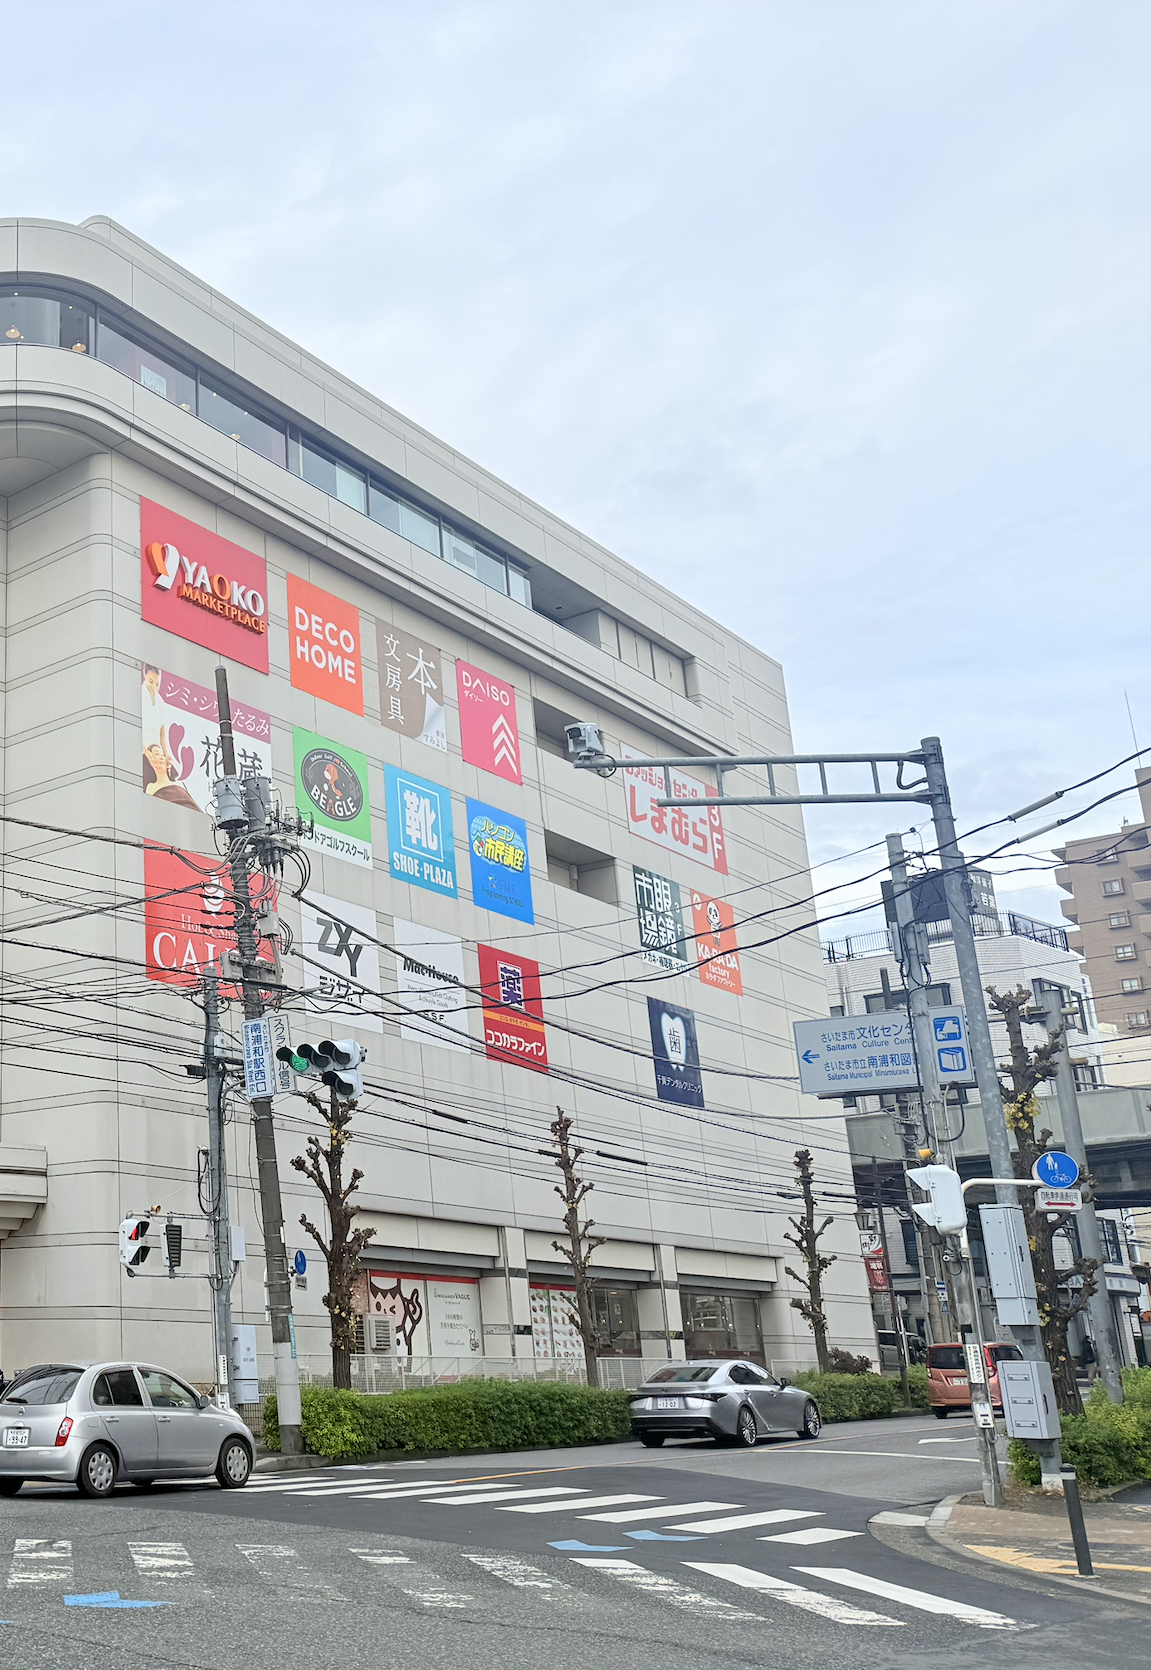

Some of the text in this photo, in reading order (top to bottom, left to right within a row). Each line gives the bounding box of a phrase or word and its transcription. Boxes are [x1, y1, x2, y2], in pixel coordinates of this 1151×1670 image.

[180, 555, 265, 617] YAOKO
[180, 583, 266, 634] MARKETPLACE
[295, 605, 355, 654] DECO
[296, 635, 357, 684] HOME
[383, 633, 405, 725] 文房具
[406, 647, 438, 695] 本
[462, 670, 510, 707] DAISO
[463, 689, 484, 703] ダイソー
[310, 784, 358, 817] BEAGLE
[403, 788, 438, 851] 靴
[630, 784, 708, 855] しまむら
[481, 818, 515, 842] パソコン
[484, 837, 525, 872] 市民講座
[500, 966, 523, 1007] 薬
[709, 961, 730, 978] factory
[486, 1029, 545, 1056] ココカラファイン
[669, 1028, 681, 1054] 歯
[820, 1022, 912, 1043] さいたま市文化センタ
[826, 1036, 917, 1051] Saitama Culture Cente
[250, 1023, 267, 1093] 南浦和駅西口
[274, 1019, 291, 1090] スクラル信号
[824, 1053, 919, 1072] さいたま市立南浦和図
